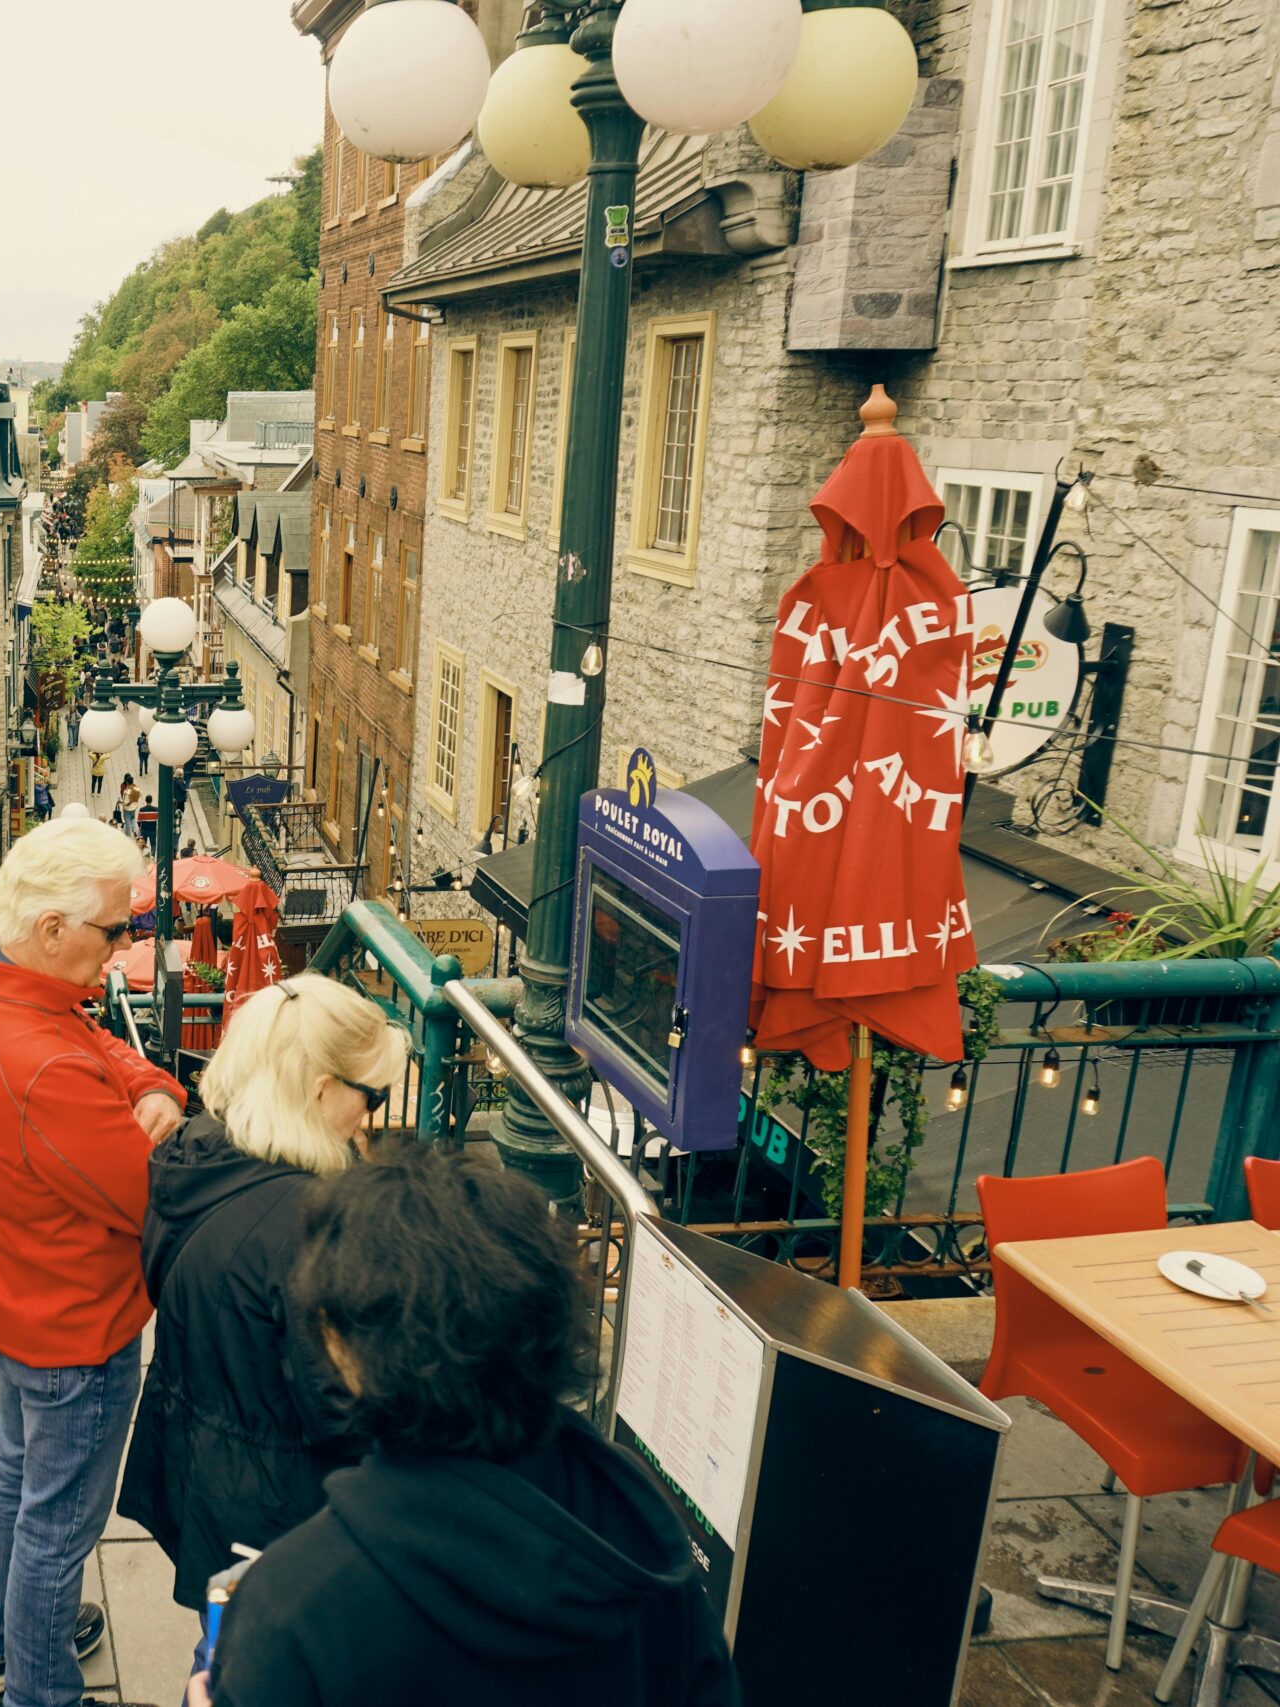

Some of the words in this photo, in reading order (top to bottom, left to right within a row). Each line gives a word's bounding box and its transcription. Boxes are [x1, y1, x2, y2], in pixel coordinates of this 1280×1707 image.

[1011, 701, 1059, 718] PUB
[595, 794, 639, 834] POULET
[643, 822, 683, 861] ROYAL
[648, 850, 655, 859] LA
[450, 930, 484, 943] D'ICI
